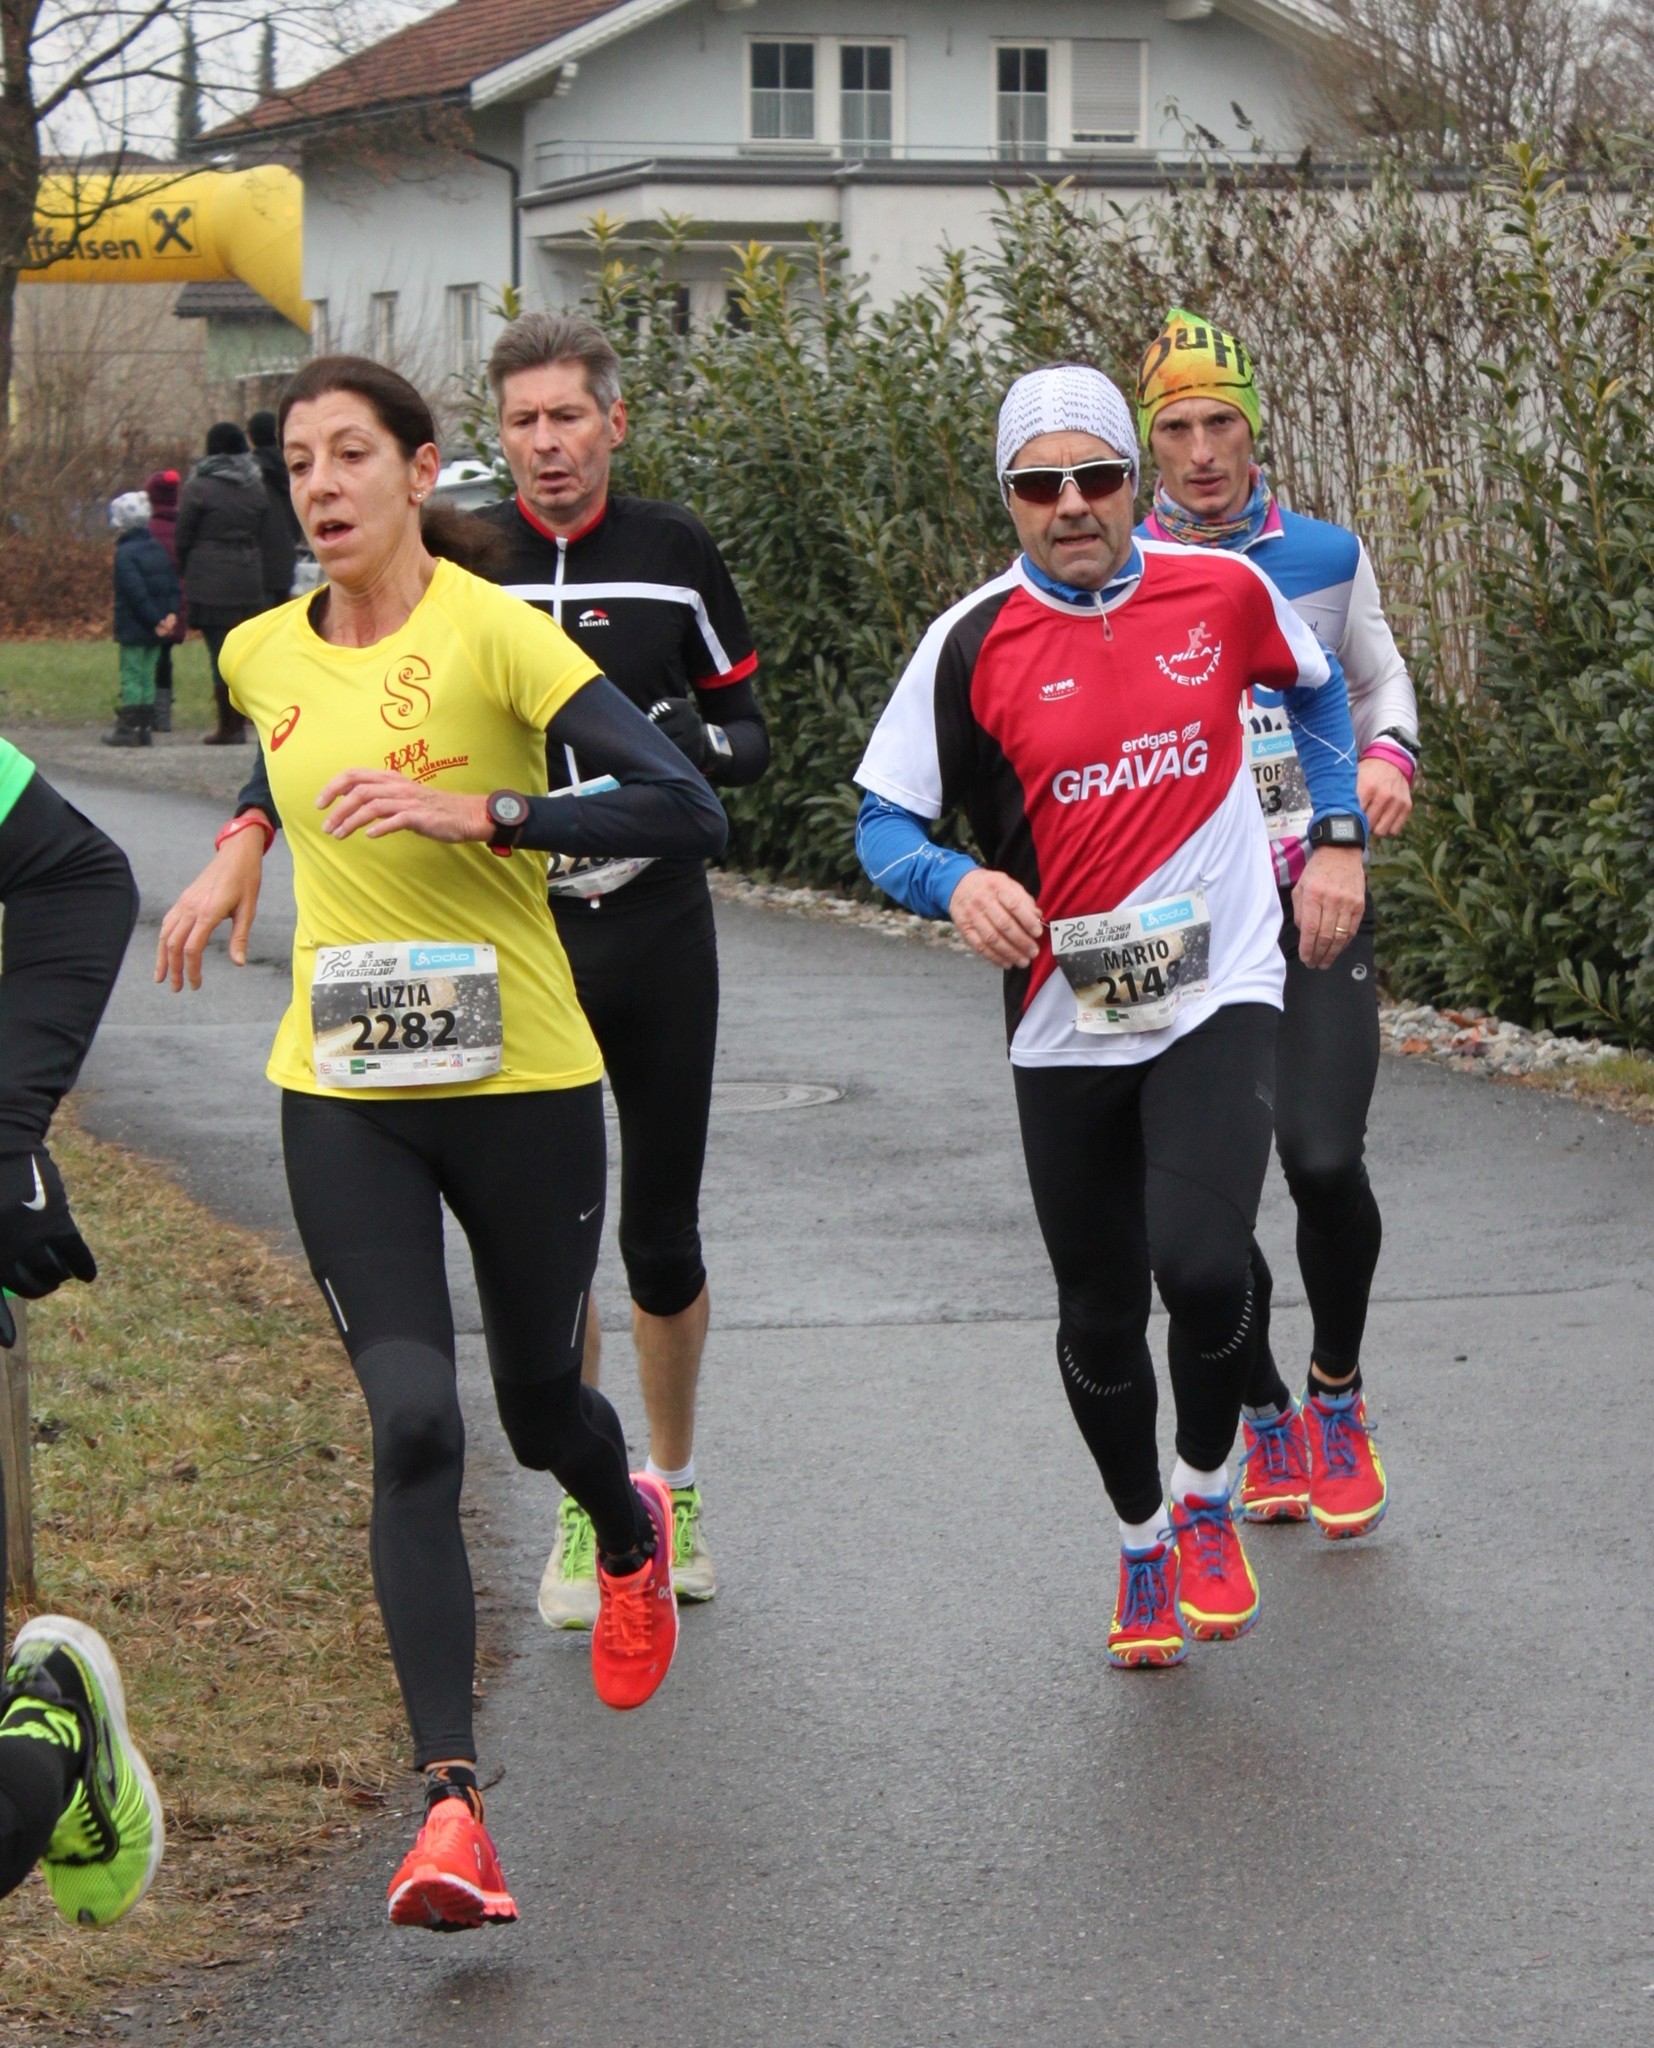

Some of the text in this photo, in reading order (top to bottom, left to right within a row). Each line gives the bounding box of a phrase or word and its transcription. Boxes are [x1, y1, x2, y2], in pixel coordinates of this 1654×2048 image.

[579, 618, 610, 627] skinfit
[1155, 640, 1222, 687] RHEINTAL
[1169, 646, 1213, 664] MILA
[1121, 730, 1178, 753] erdgas
[1052, 740, 1208, 804] GRAVAG
[1103, 939, 1170, 971] MARIO
[367, 983, 431, 1010] LUZIA
[1096, 960, 1182, 1005] 2148
[350, 1010, 458, 1052] 2282
